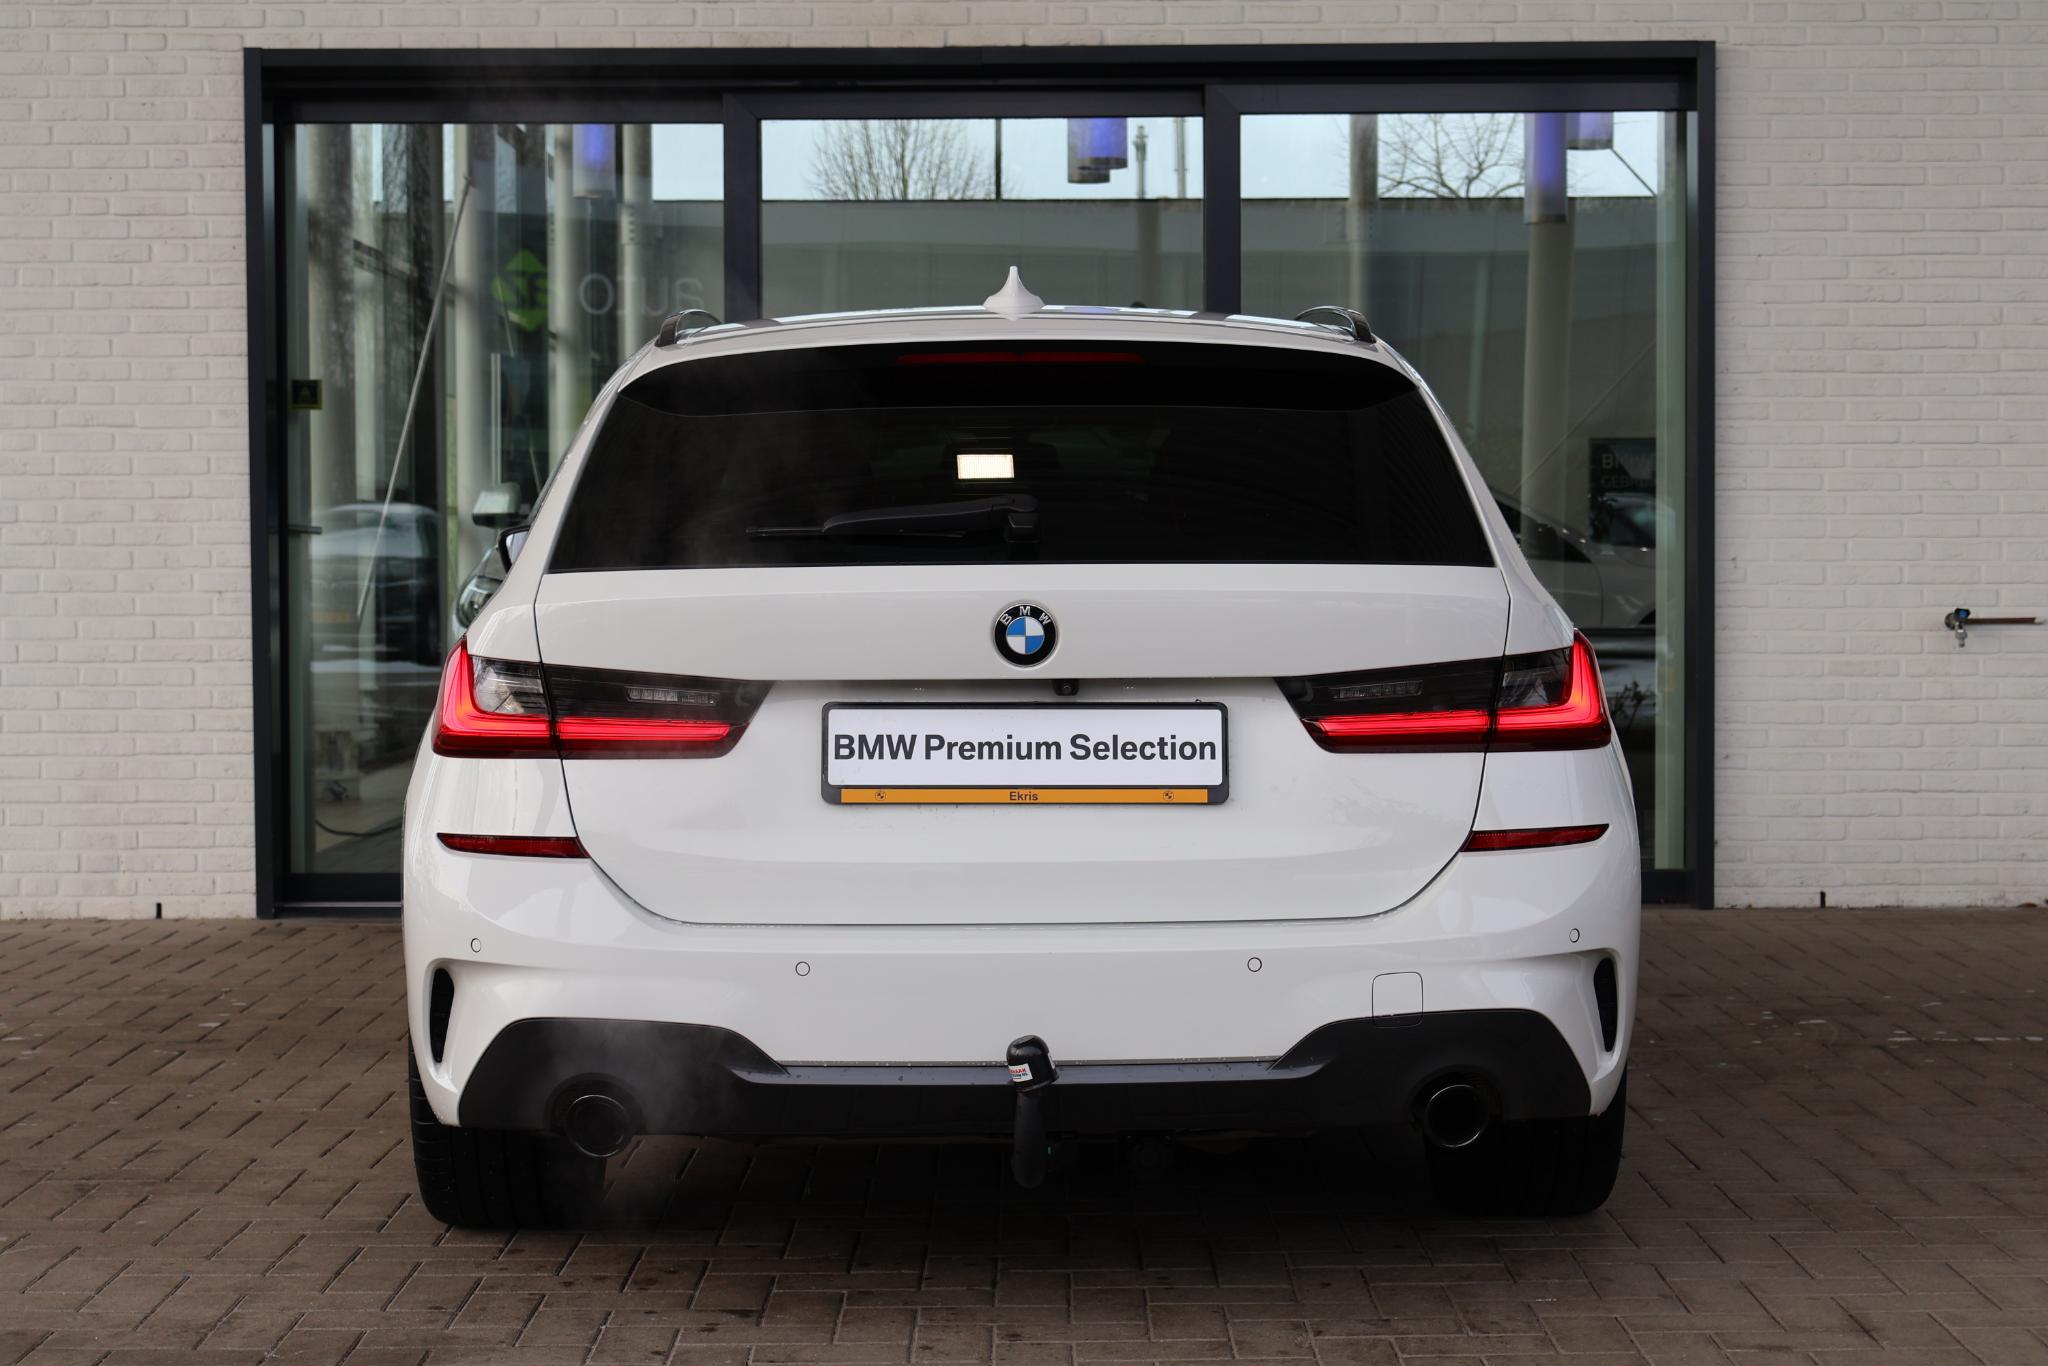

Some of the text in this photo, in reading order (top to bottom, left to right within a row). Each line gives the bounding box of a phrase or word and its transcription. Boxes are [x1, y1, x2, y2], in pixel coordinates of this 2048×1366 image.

[1000, 606, 1051, 625] BMW
[834, 733, 1217, 760] BMW Premium Selection
[1009, 791, 1039, 801] Ekris
